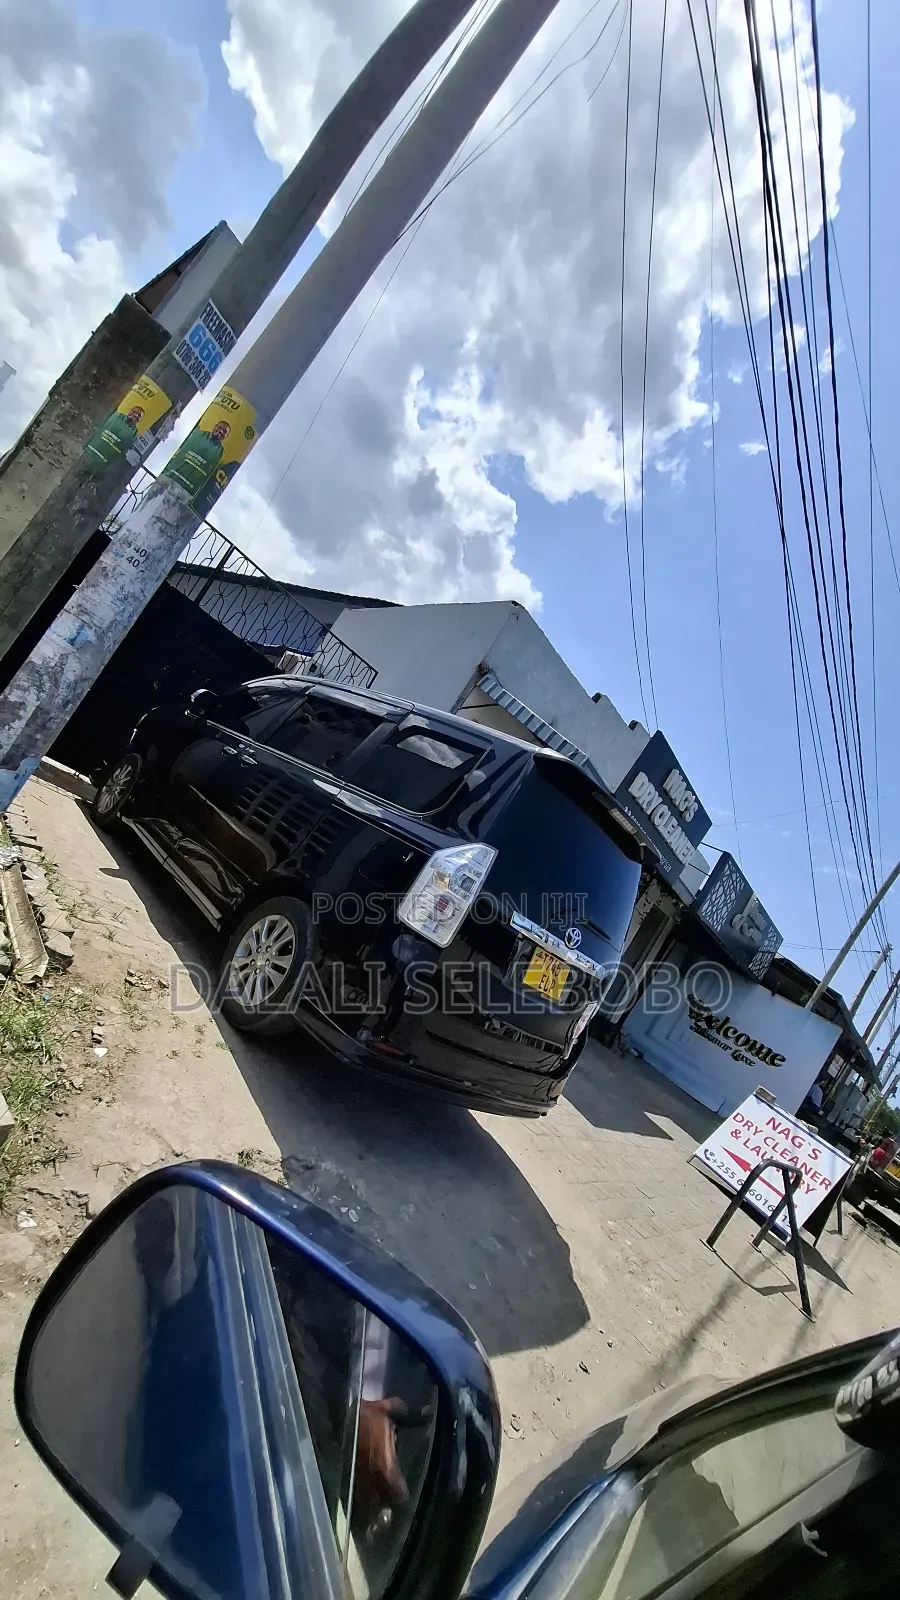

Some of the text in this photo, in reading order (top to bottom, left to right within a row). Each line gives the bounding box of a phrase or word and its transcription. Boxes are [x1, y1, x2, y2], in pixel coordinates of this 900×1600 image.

[188, 323, 223, 374] 666
[627, 771, 663, 816] DRY
[651, 803, 697, 866] CLEANER
[686, 993, 787, 1068] Welcome
[730, 1128, 743, 1141] &
[732, 1112, 833, 1191] DRY CLEANER
[711, 1156, 738, 1180] +255
